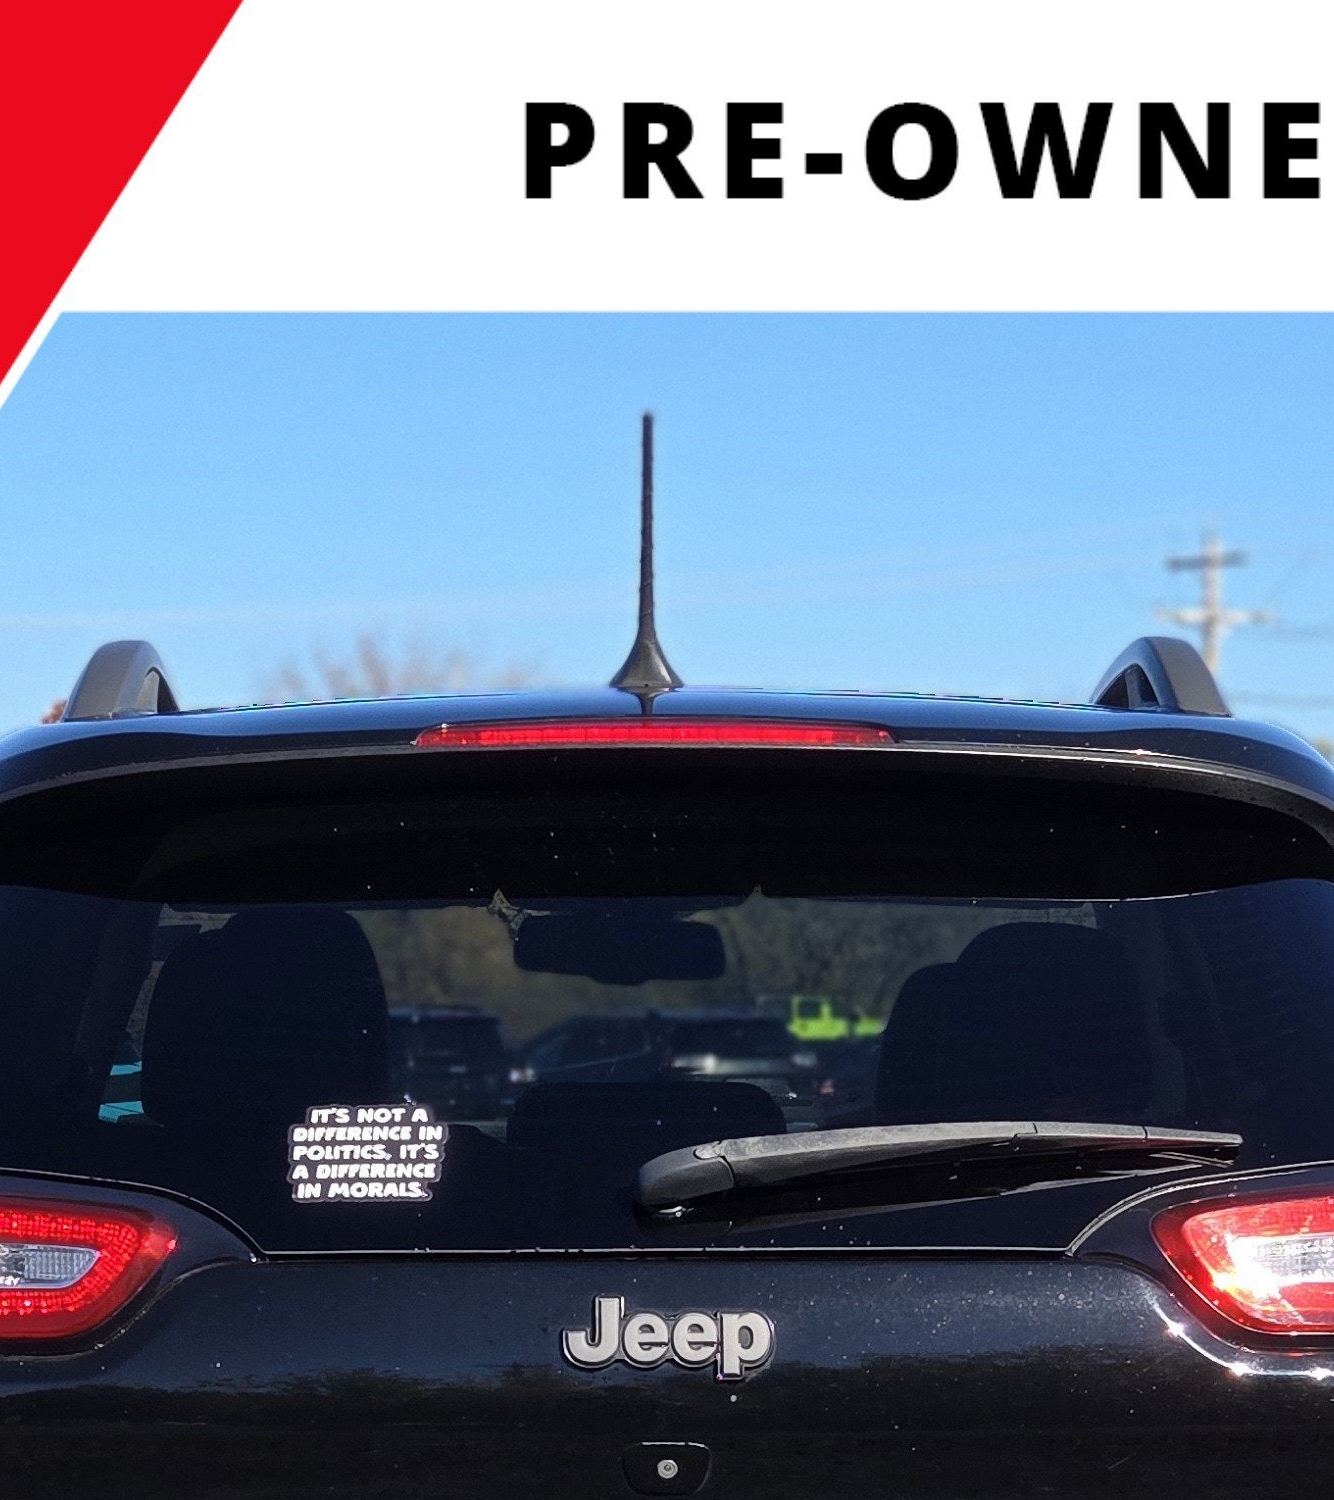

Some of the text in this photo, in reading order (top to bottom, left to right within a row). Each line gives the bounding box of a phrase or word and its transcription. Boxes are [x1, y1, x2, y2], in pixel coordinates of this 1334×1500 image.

[310, 1107, 429, 1124] IT'S NOT A
[292, 1125, 443, 1142] DIFFERENCE IN
[399, 1143, 440, 1160] IT'S
[291, 1163, 437, 1180] A DIFFERENCE
[296, 1182, 322, 1199] IN
[563, 1296, 774, 1380] Jeep
